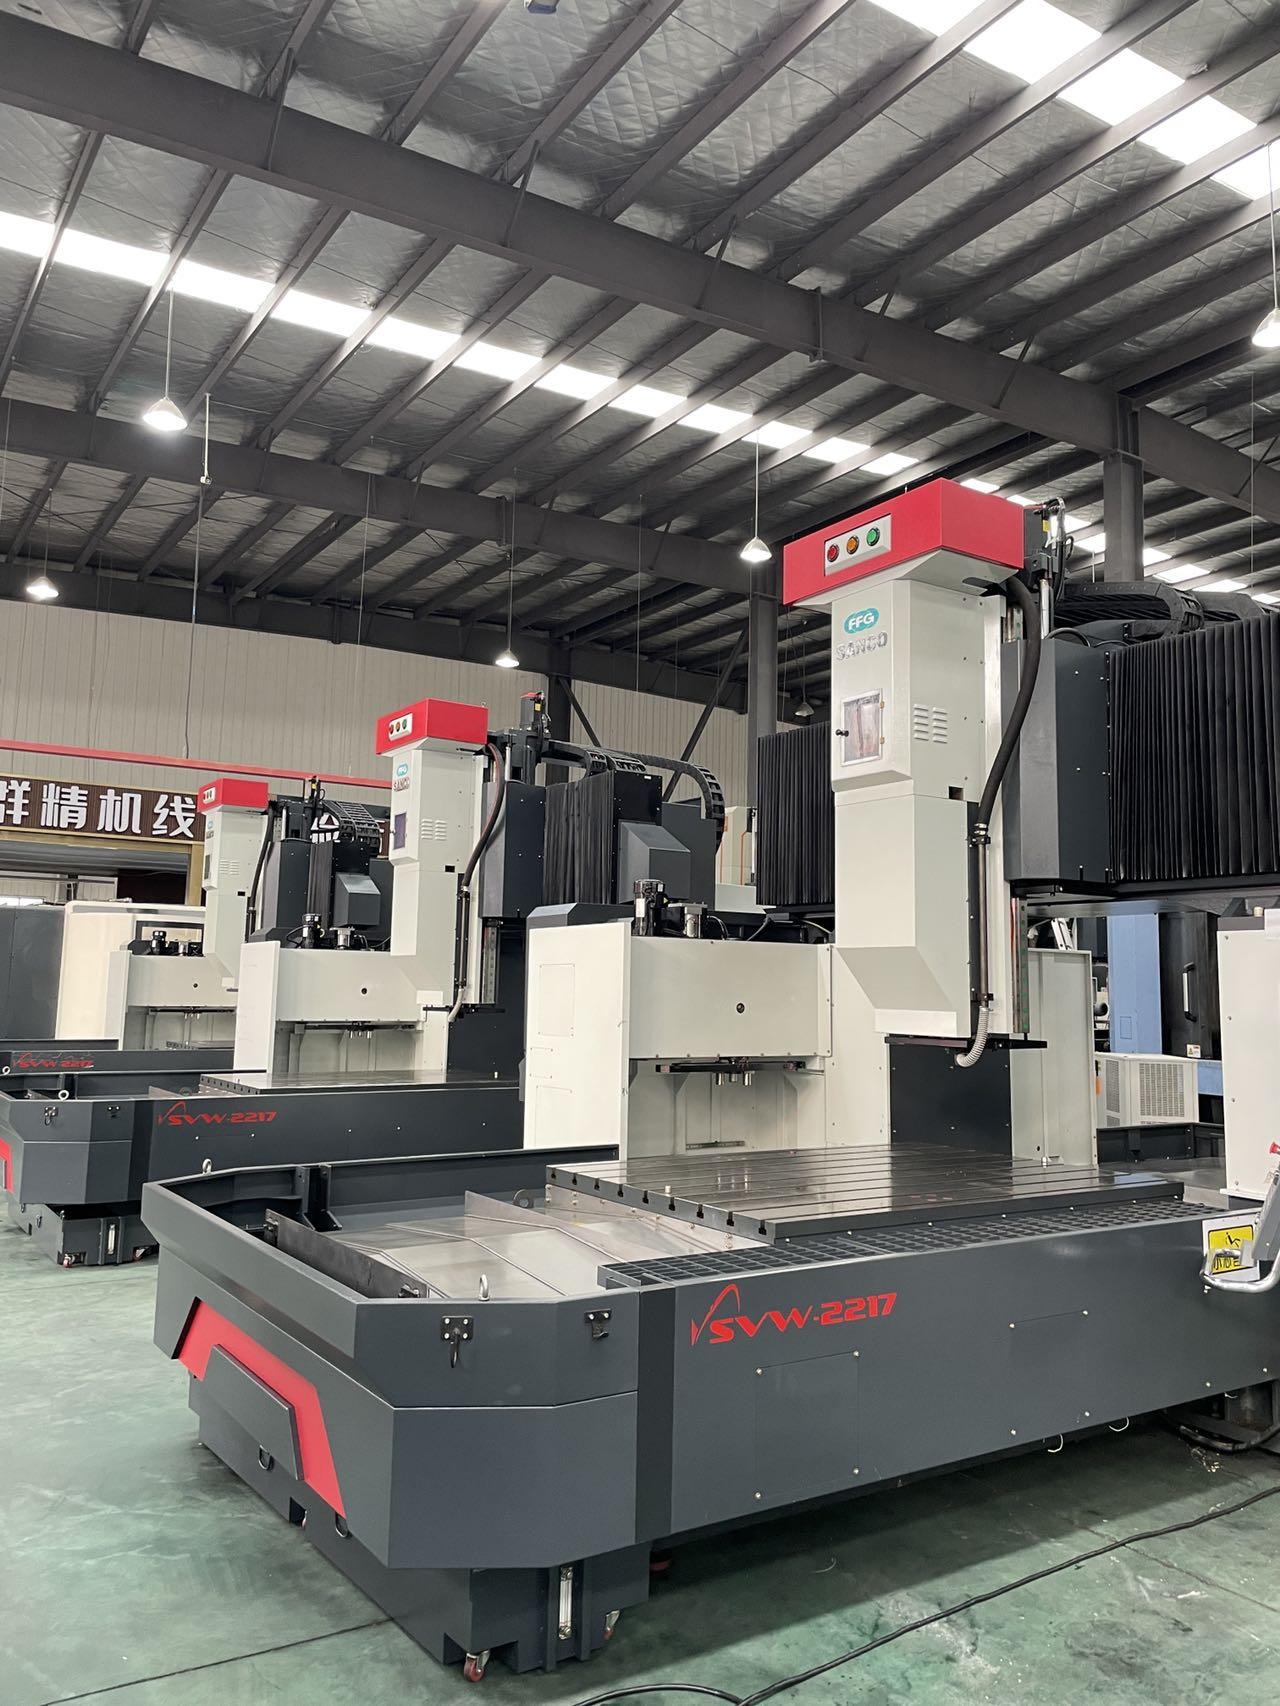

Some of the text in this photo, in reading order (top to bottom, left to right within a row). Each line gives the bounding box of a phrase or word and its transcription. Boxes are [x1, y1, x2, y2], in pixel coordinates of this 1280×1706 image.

[846, 610, 876, 632] FFG
[836, 632, 887, 661] SANCO
[167, 1110, 278, 1126] SVW-2217
[708, 1292, 898, 1344] SVW-2217
